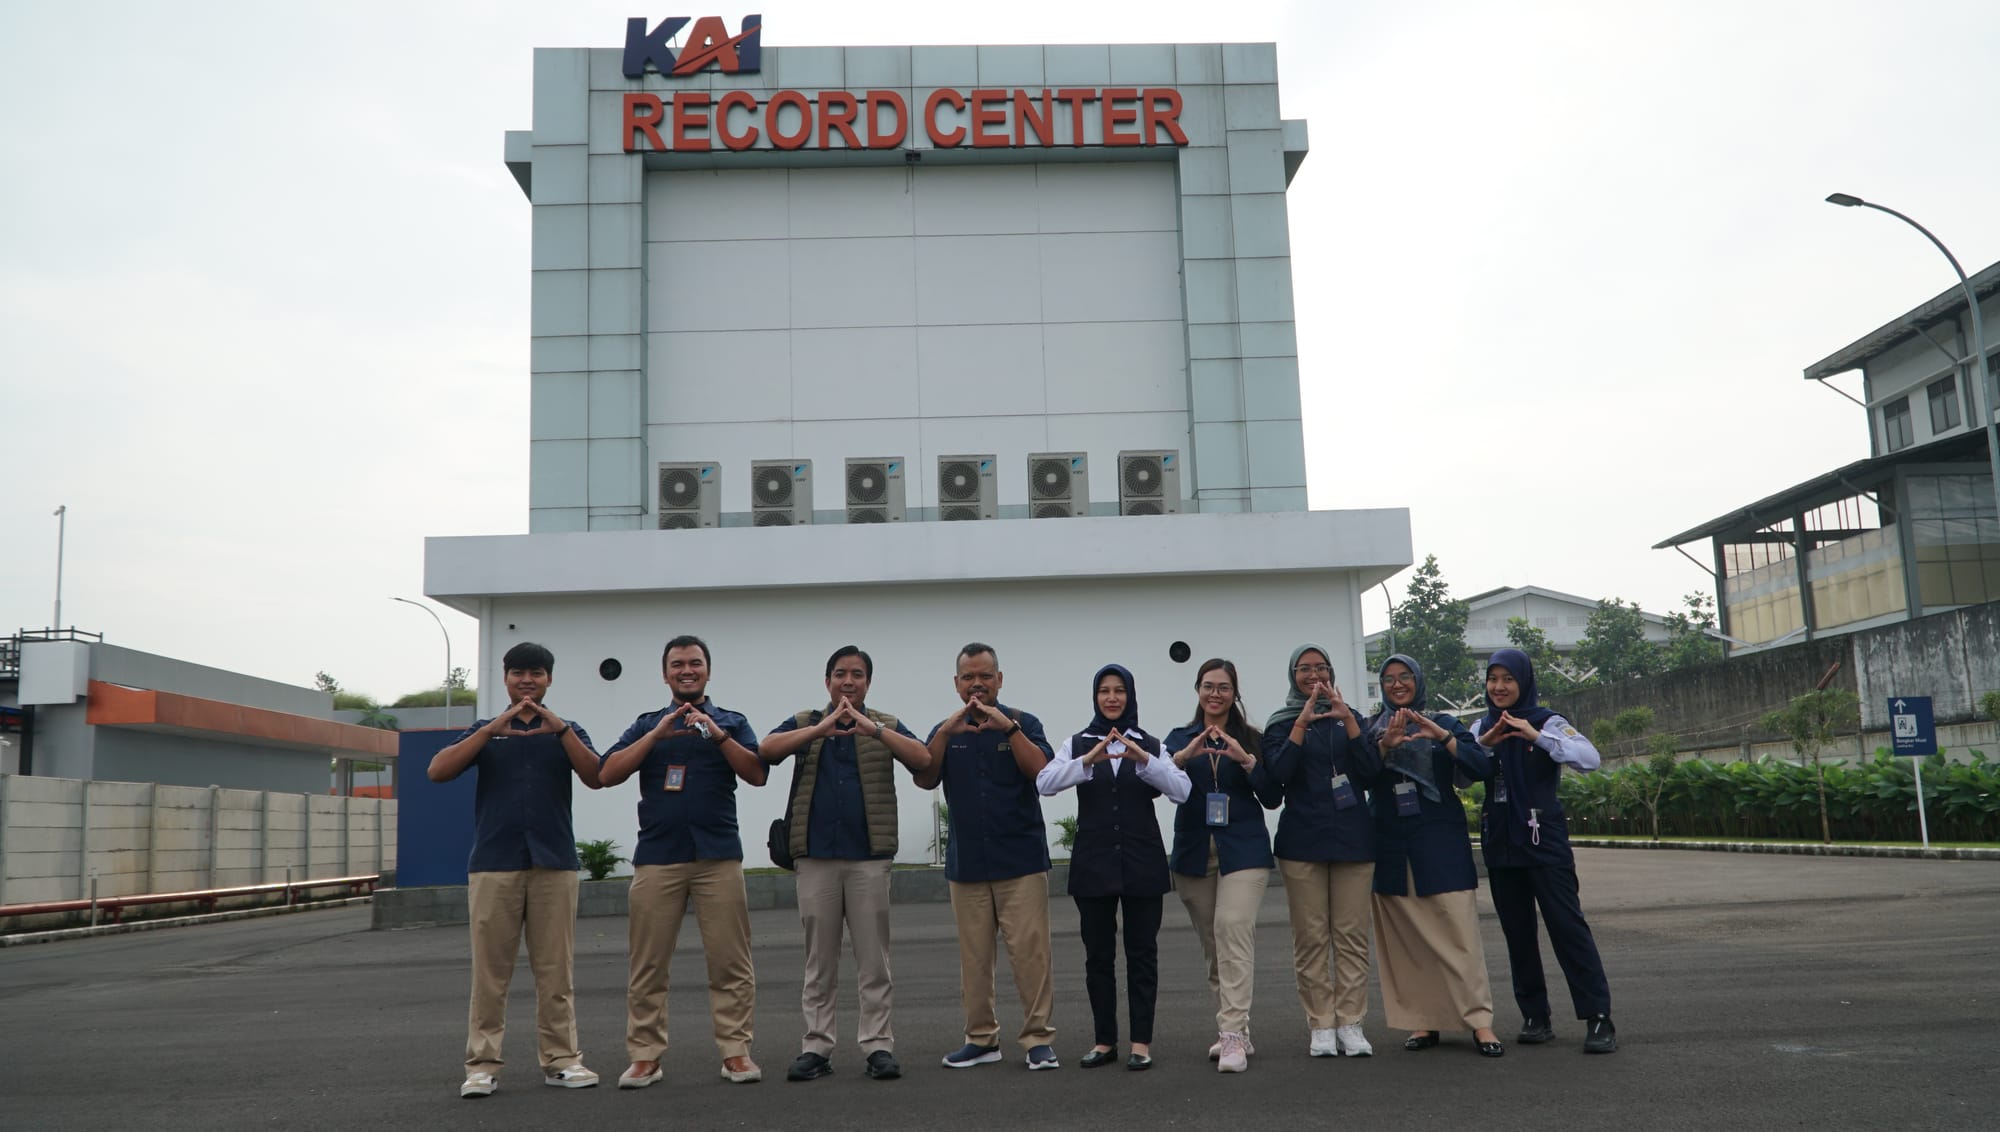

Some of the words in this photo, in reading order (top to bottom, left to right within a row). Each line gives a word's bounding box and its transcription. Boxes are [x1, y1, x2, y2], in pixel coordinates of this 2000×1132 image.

[623, 14, 761, 77] KAI
[623, 91, 907, 151] RECORD
[925, 88, 1188, 147] CENTER
